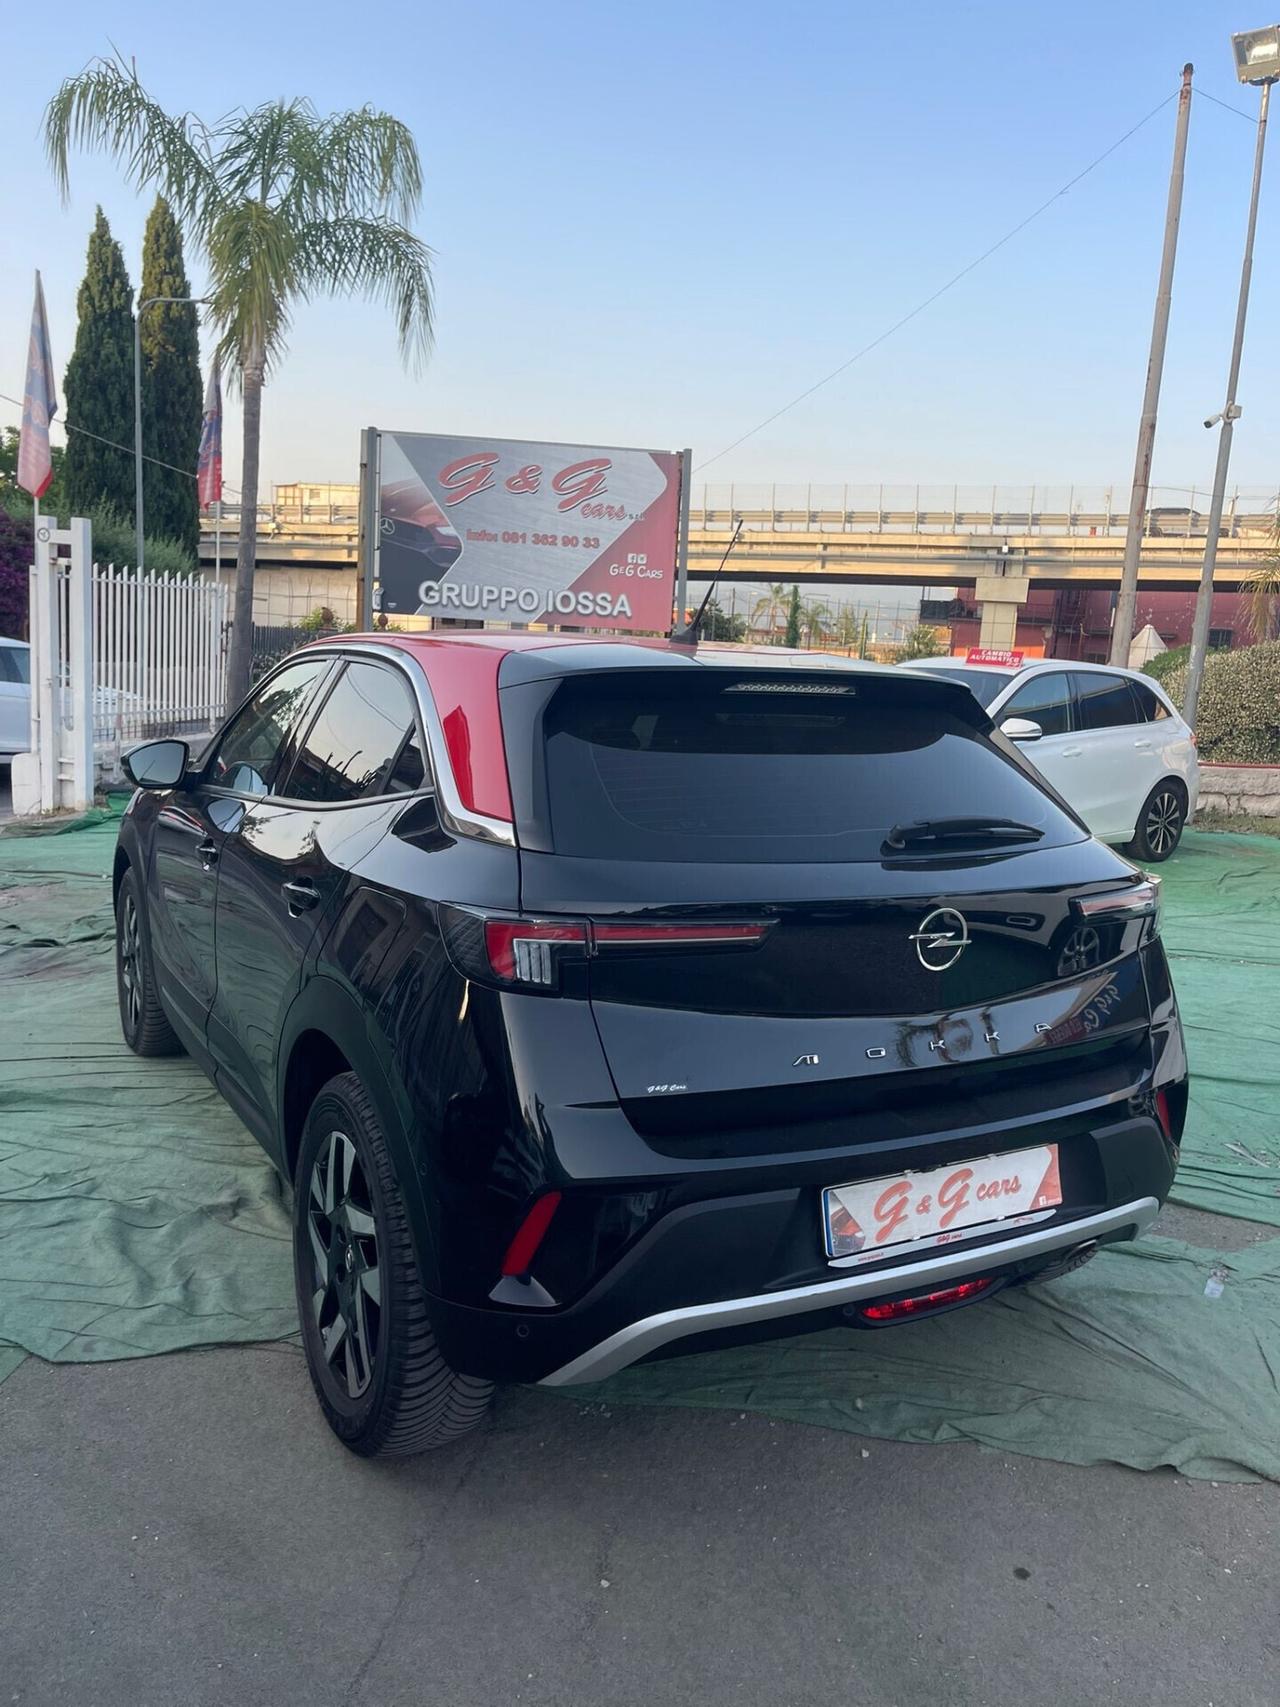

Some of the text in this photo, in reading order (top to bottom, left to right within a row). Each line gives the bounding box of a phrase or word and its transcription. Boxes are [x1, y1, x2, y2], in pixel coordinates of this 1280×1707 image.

[437, 452, 613, 513] G & G
[580, 502, 627, 521] cars
[418, 580, 633, 618] GRUPPO IOSSA
[970, 655, 1020, 663] AUTOMATICO
[873, 1168, 1022, 1243] G & G cars
